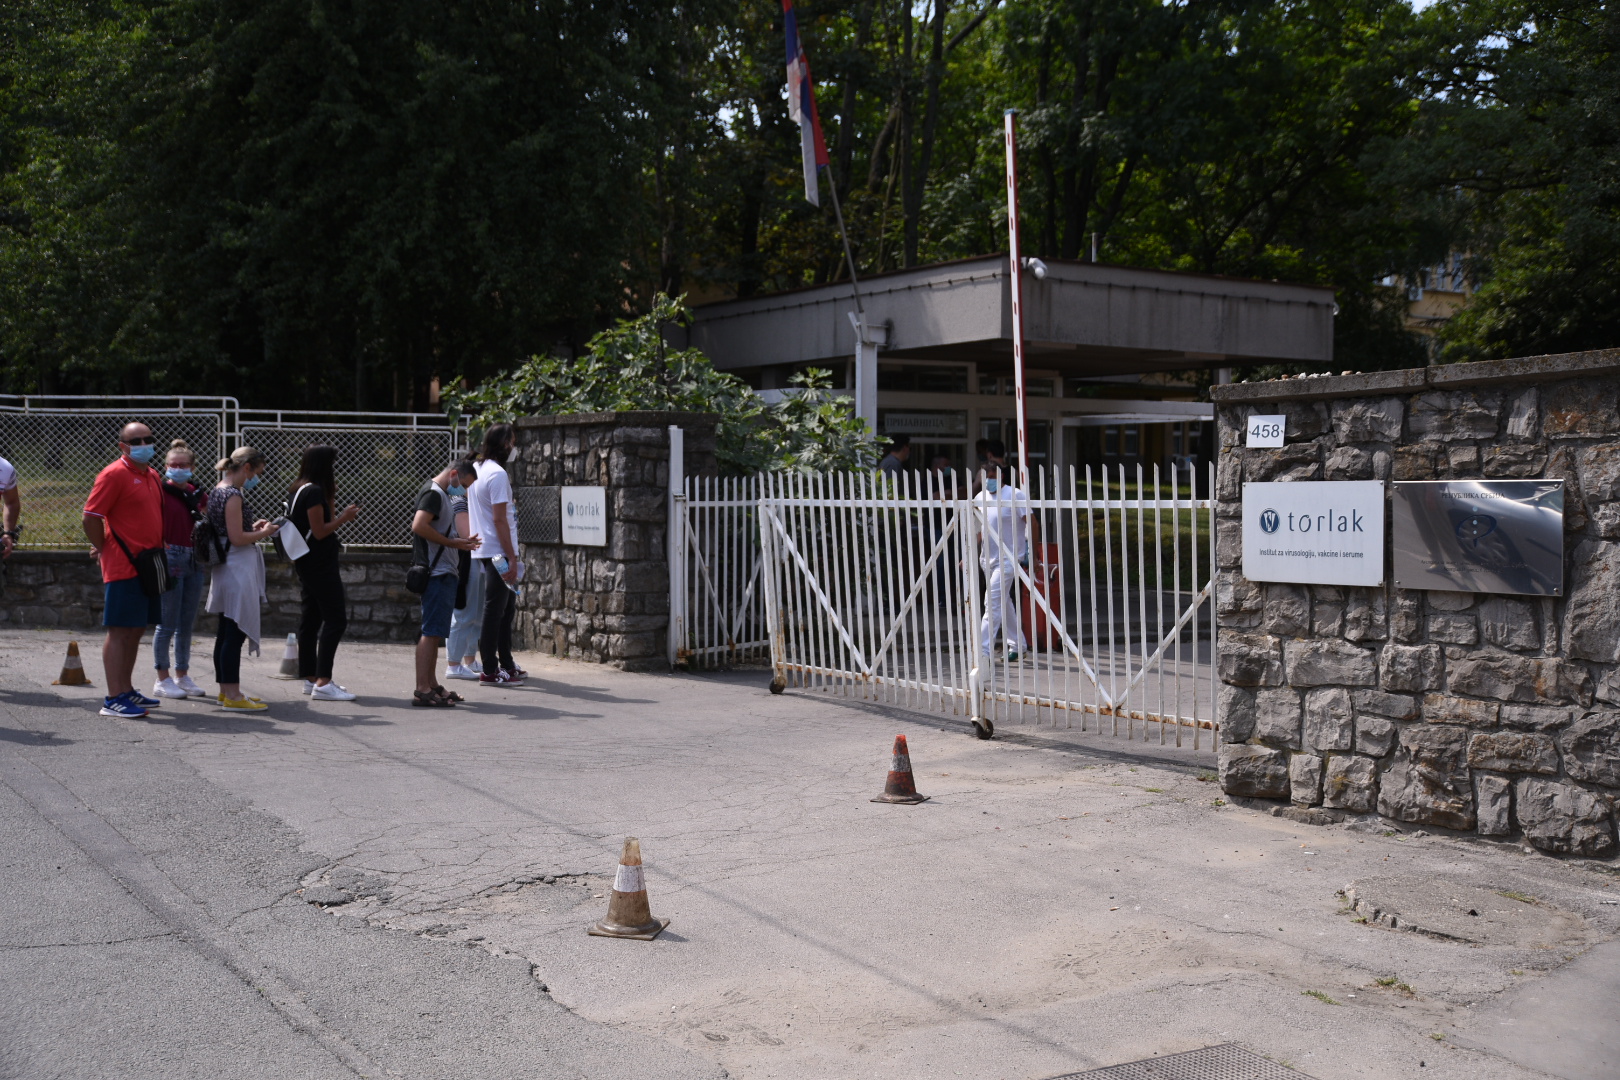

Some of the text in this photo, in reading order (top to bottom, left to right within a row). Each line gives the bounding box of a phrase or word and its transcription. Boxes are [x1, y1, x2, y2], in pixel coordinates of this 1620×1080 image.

[1251, 423, 1280, 439] 458
[575, 501, 600, 516] torlak
[1287, 508, 1364, 533] torlak
[1259, 548, 1277, 556] Institut
[1284, 548, 1317, 558] virusologiju,
[1317, 549, 1339, 558] vakcine
[1342, 551, 1364, 559] serume
